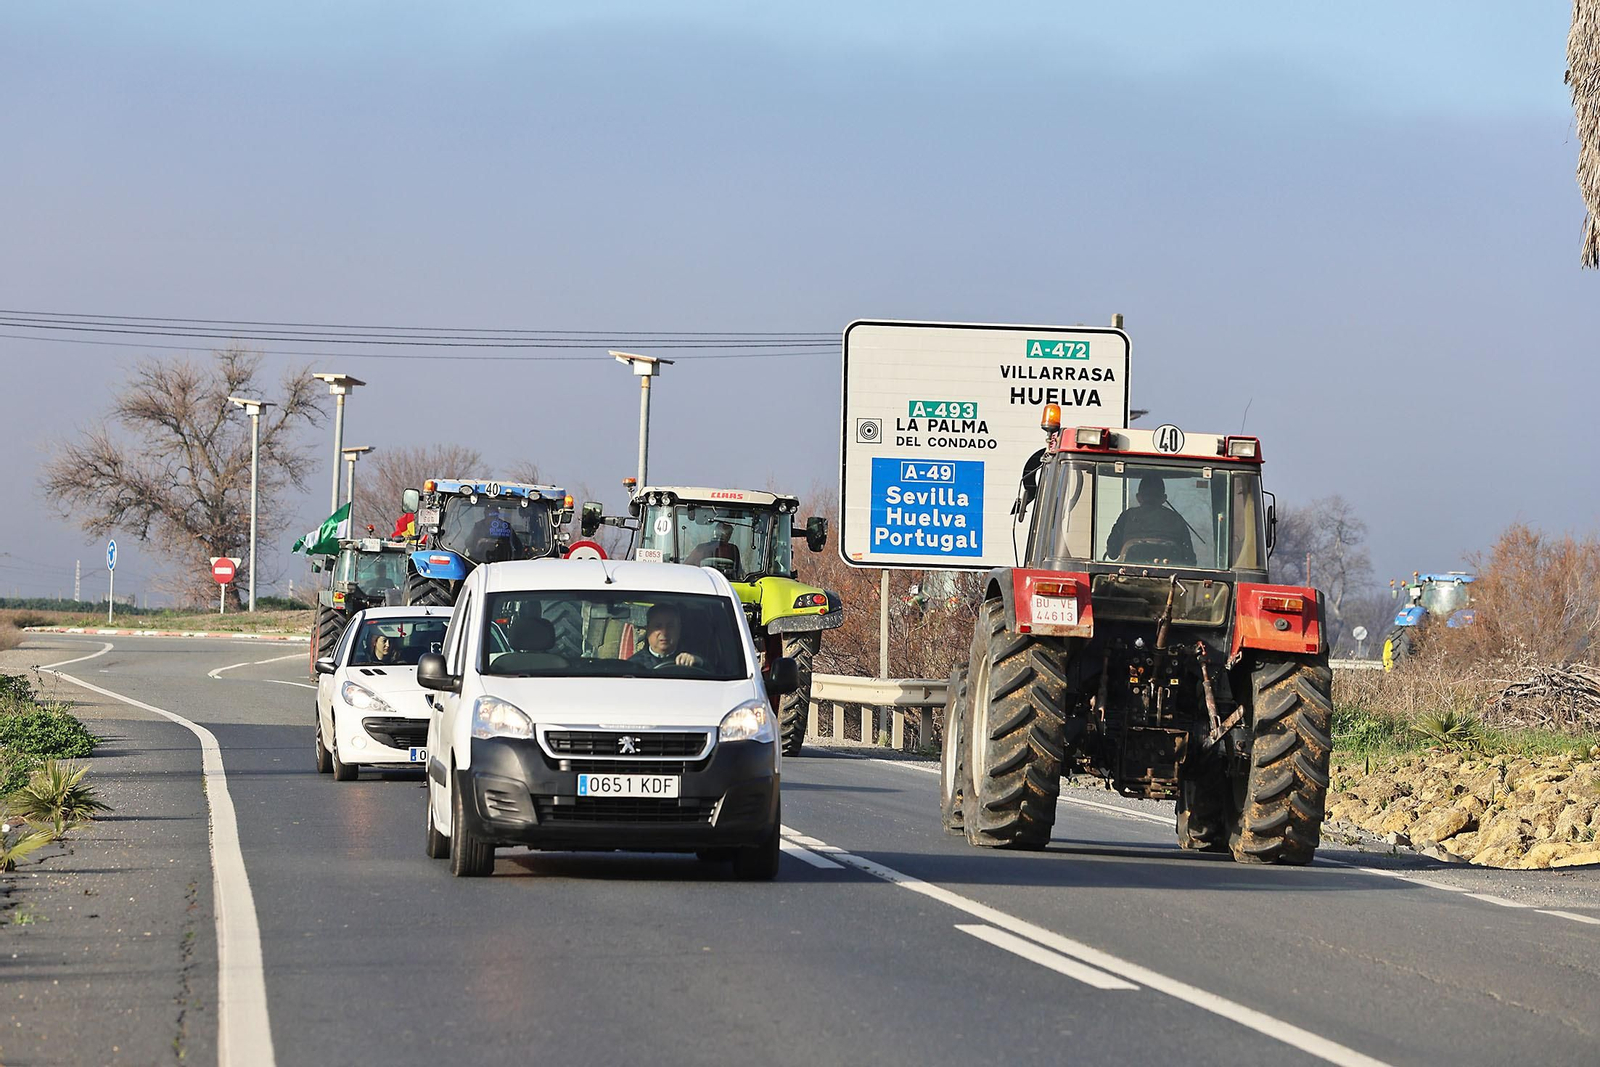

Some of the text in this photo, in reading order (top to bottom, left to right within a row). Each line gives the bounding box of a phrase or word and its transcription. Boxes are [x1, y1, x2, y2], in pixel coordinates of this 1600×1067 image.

[1029, 341, 1088, 358] A-472
[1000, 364, 1116, 382] VILLARRASA
[1010, 387, 1102, 407] HUELVA
[912, 401, 975, 419] A-493
[896, 418, 989, 434] LA PALMA
[896, 436, 998, 450] DEL CONDADO
[1159, 427, 1178, 452] 40
[904, 464, 952, 481] A-49
[485, 482, 499, 496] 40
[710, 491, 744, 500] CLAAS
[885, 486, 970, 507] Sevilla
[656, 519, 669, 533] 40
[886, 507, 967, 528] Huelva
[874, 527, 978, 553] Portugal
[645, 550, 661, 558] 0853
[1036, 611, 1073, 622] 44613
[590, 777, 673, 793] 0651 KDF
